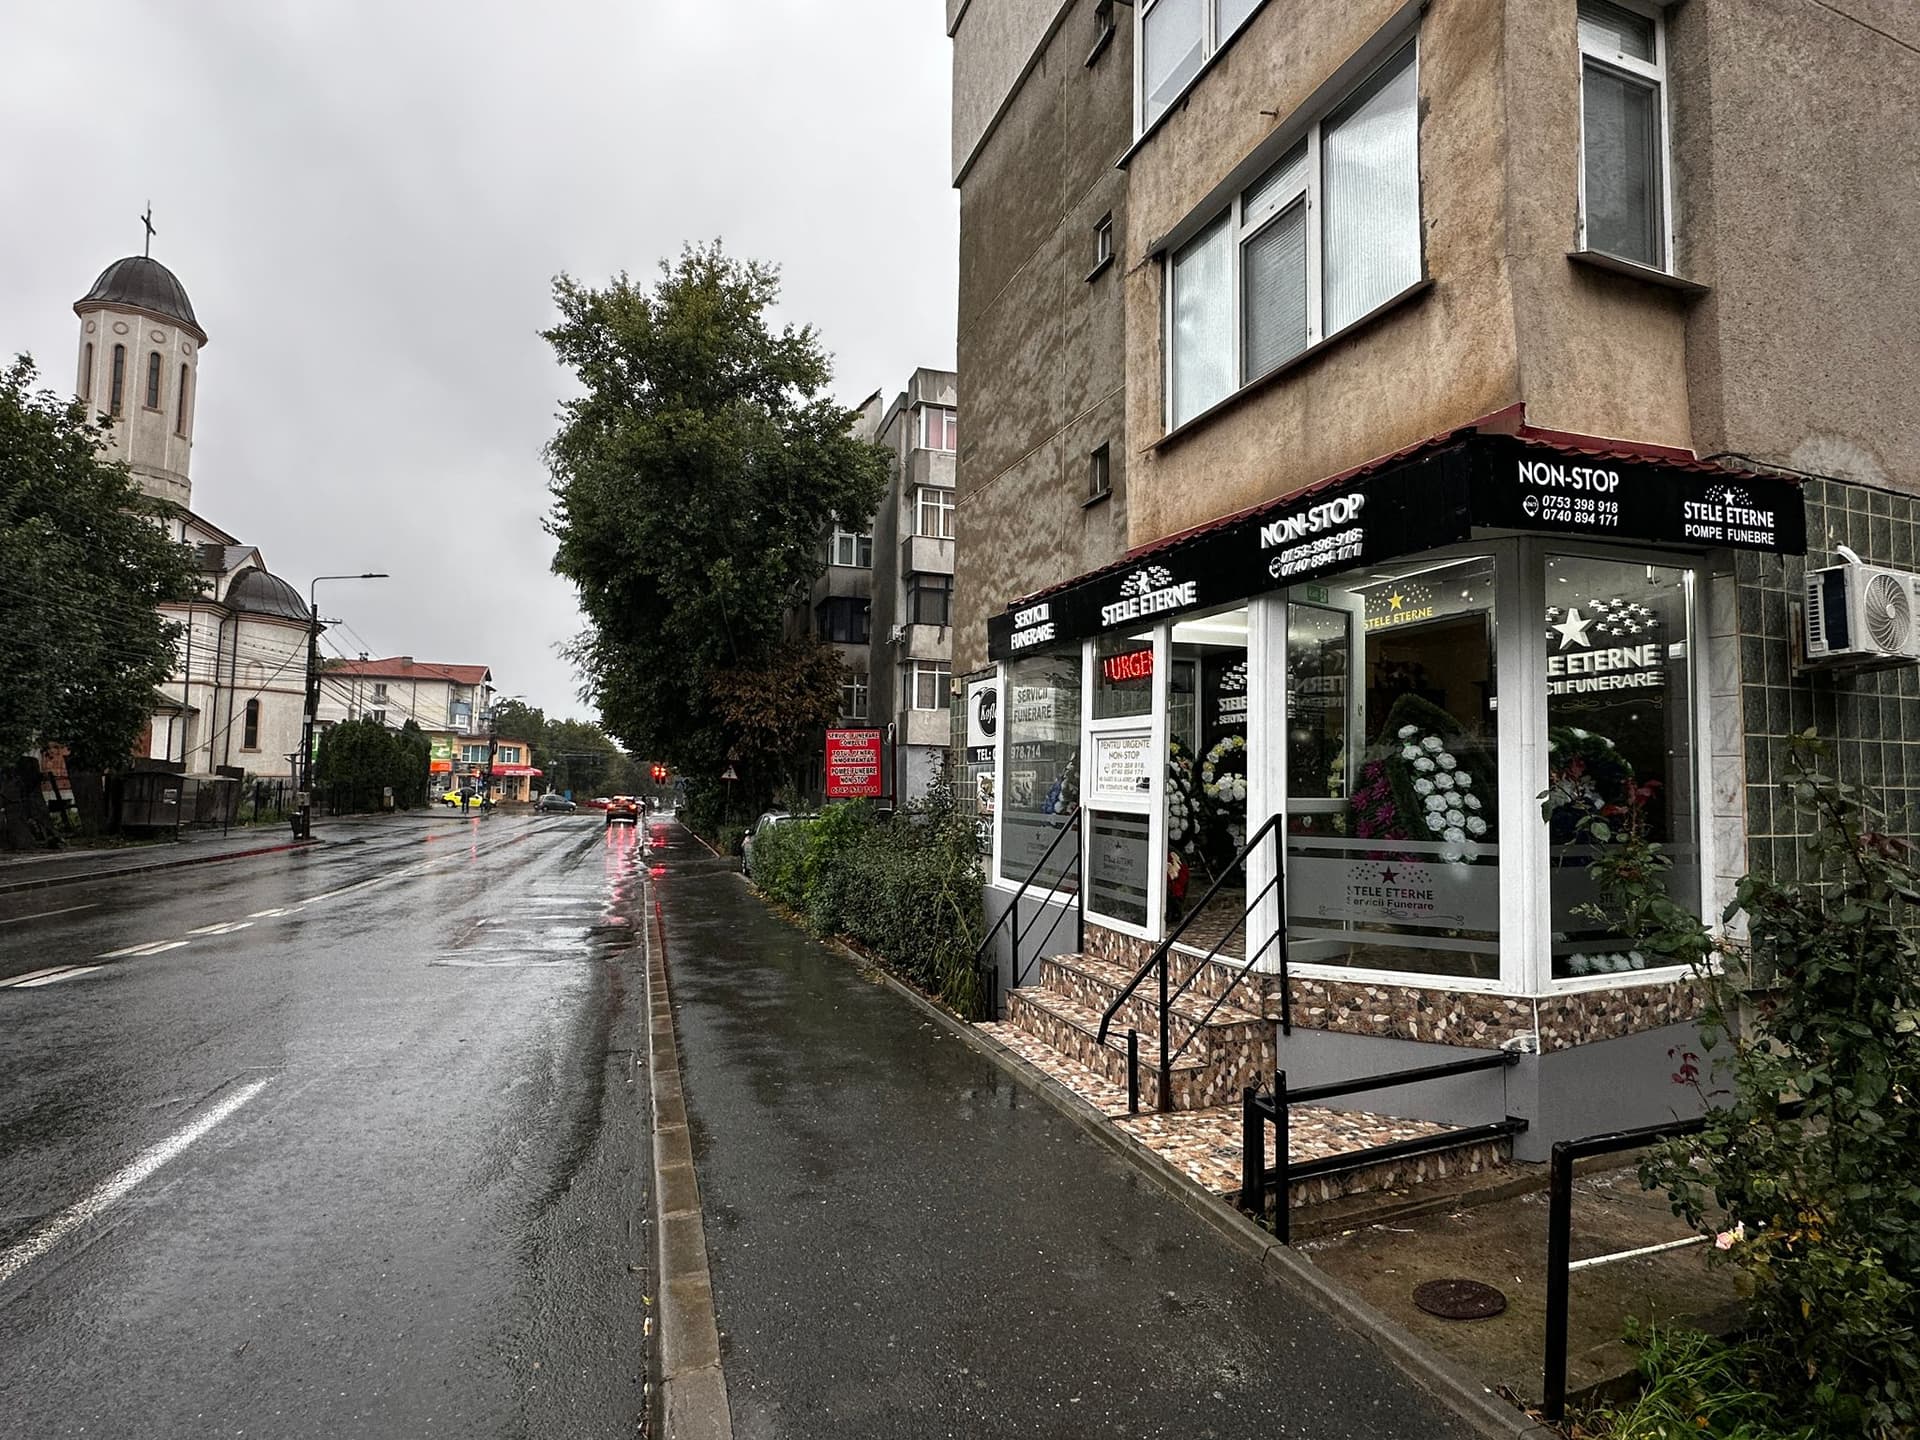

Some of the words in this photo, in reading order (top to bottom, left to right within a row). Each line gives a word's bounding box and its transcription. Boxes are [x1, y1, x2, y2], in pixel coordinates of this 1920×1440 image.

[1518, 460, 1619, 493] NON-STOP
[1542, 495, 1571, 509] 0753
[1574, 498, 1595, 511] 398
[1598, 500, 1618, 514] 918
[1543, 508, 1572, 522] 0740
[1574, 511, 1595, 525] 894
[1598, 513, 1618, 527] 171
[1684, 501, 1723, 522] STELE
[1726, 506, 1775, 528] ETERNE
[1260, 493, 1365, 549] NON-STOP
[1281, 544, 1311, 563] 0753
[1311, 536, 1336, 554] 398
[1336, 528, 1363, 547] 918
[1685, 524, 1723, 540] POMPE
[1727, 528, 1775, 545] FUNEBRE
[1281, 558, 1311, 577] 0740
[1311, 550, 1336, 568] 894
[1337, 542, 1363, 560] 171
[1014, 603, 1049, 629] SERVICII
[1101, 597, 1140, 627] STELE
[1140, 580, 1197, 616] ETERNE
[1362, 615, 1391, 630] STELE
[1393, 606, 1433, 624] ETERNE
[1011, 622, 1056, 650] FUNERARE
[1566, 643, 1662, 675] ETERNE
[1567, 671, 1664, 693] FUNERARE
[1013, 704, 1052, 724] FUNERARE
[976, 748, 991, 761] TEL:
[1386, 887, 1434, 900] ETERNE
